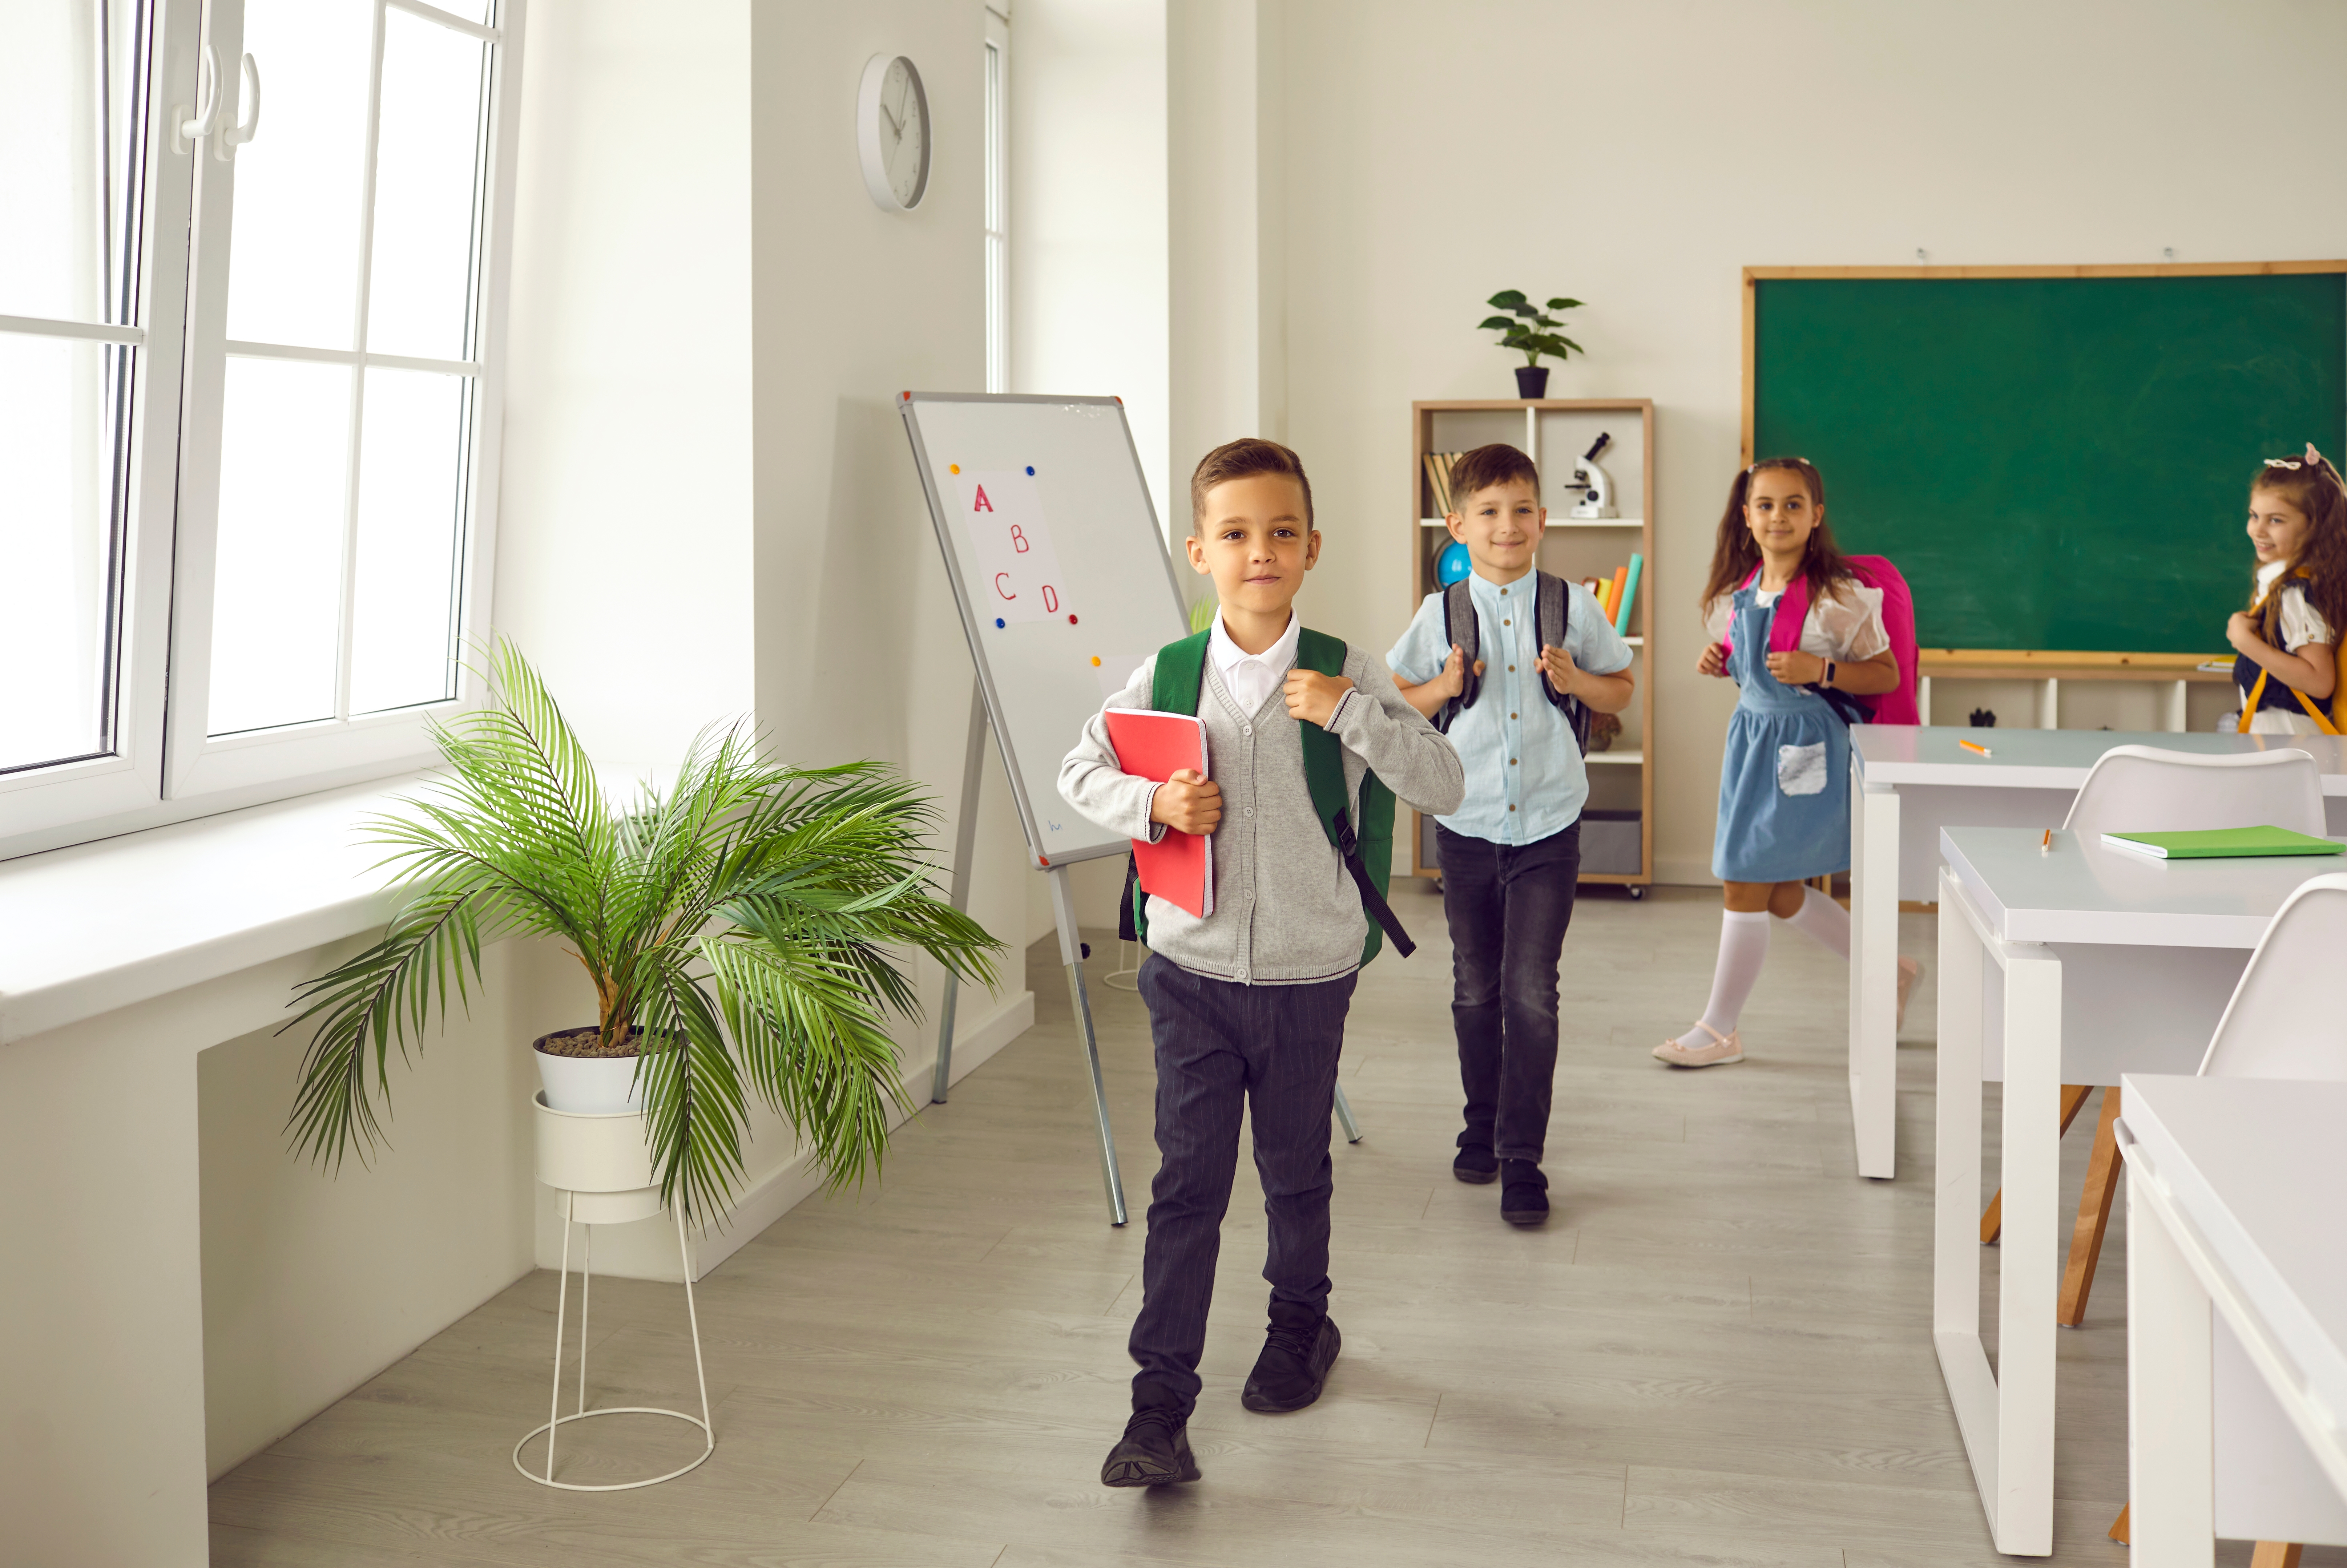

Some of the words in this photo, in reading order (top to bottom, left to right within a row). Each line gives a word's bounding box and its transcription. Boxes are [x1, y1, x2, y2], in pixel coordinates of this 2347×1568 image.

[974, 484, 993, 513] A
[1010, 524, 1029, 553] B
[995, 572, 1016, 601] C
[1042, 585, 1059, 613] D
